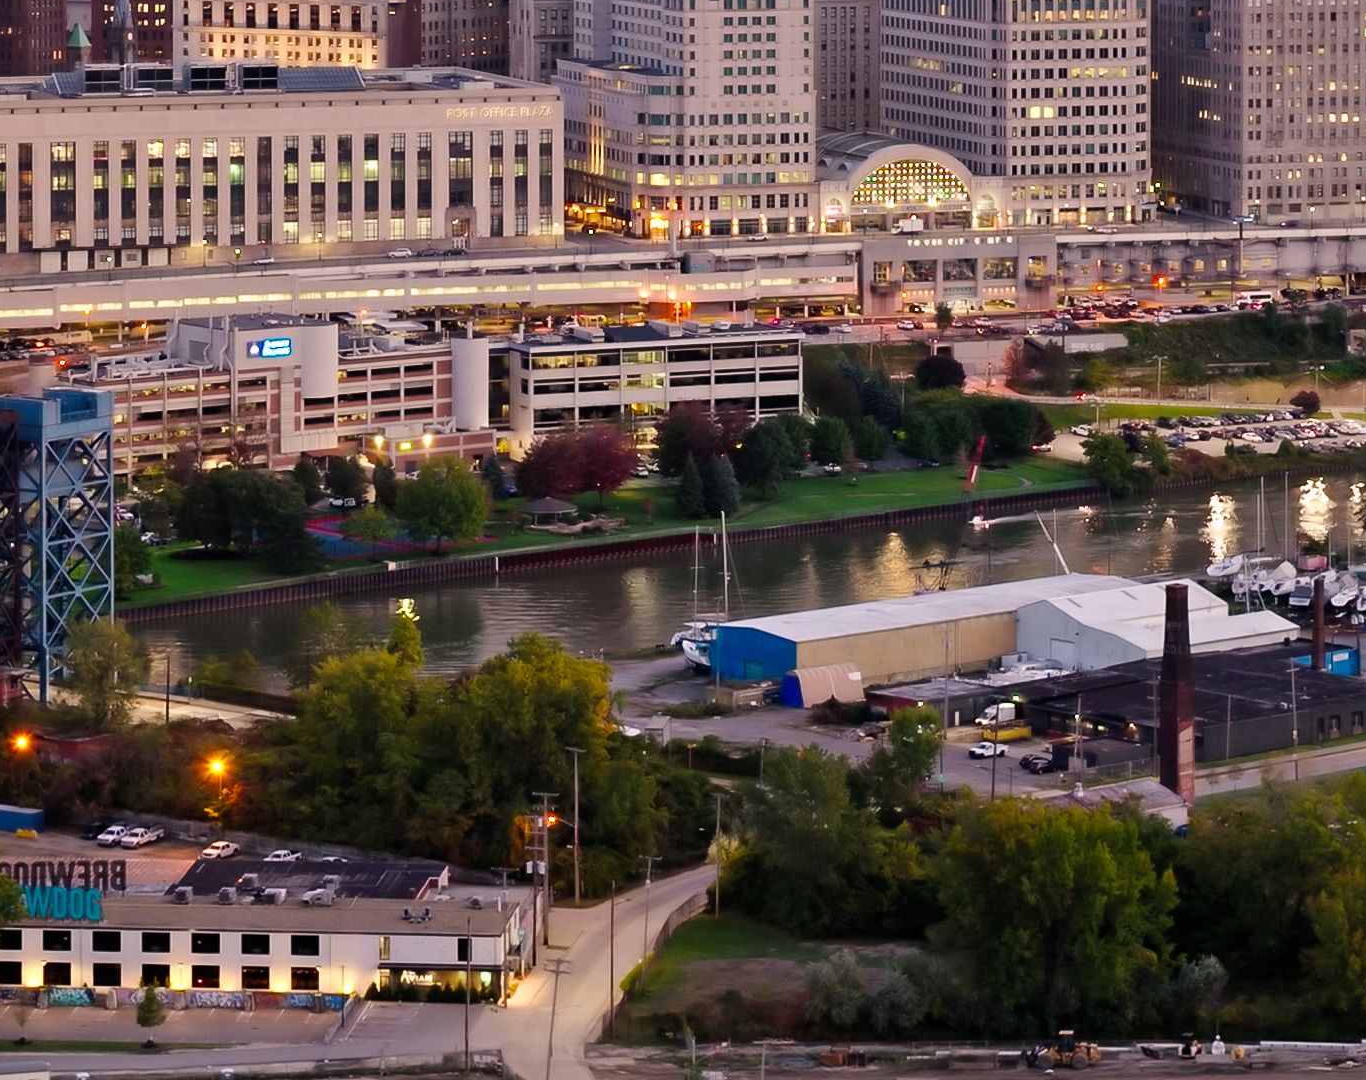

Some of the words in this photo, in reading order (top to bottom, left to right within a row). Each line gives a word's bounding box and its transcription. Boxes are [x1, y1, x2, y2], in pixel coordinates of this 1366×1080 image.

[446, 107, 476, 118] POST
[480, 106, 517, 118] OFFICE
[520, 105, 553, 117] PLAZA
[23, 886, 102, 922] WDOG
